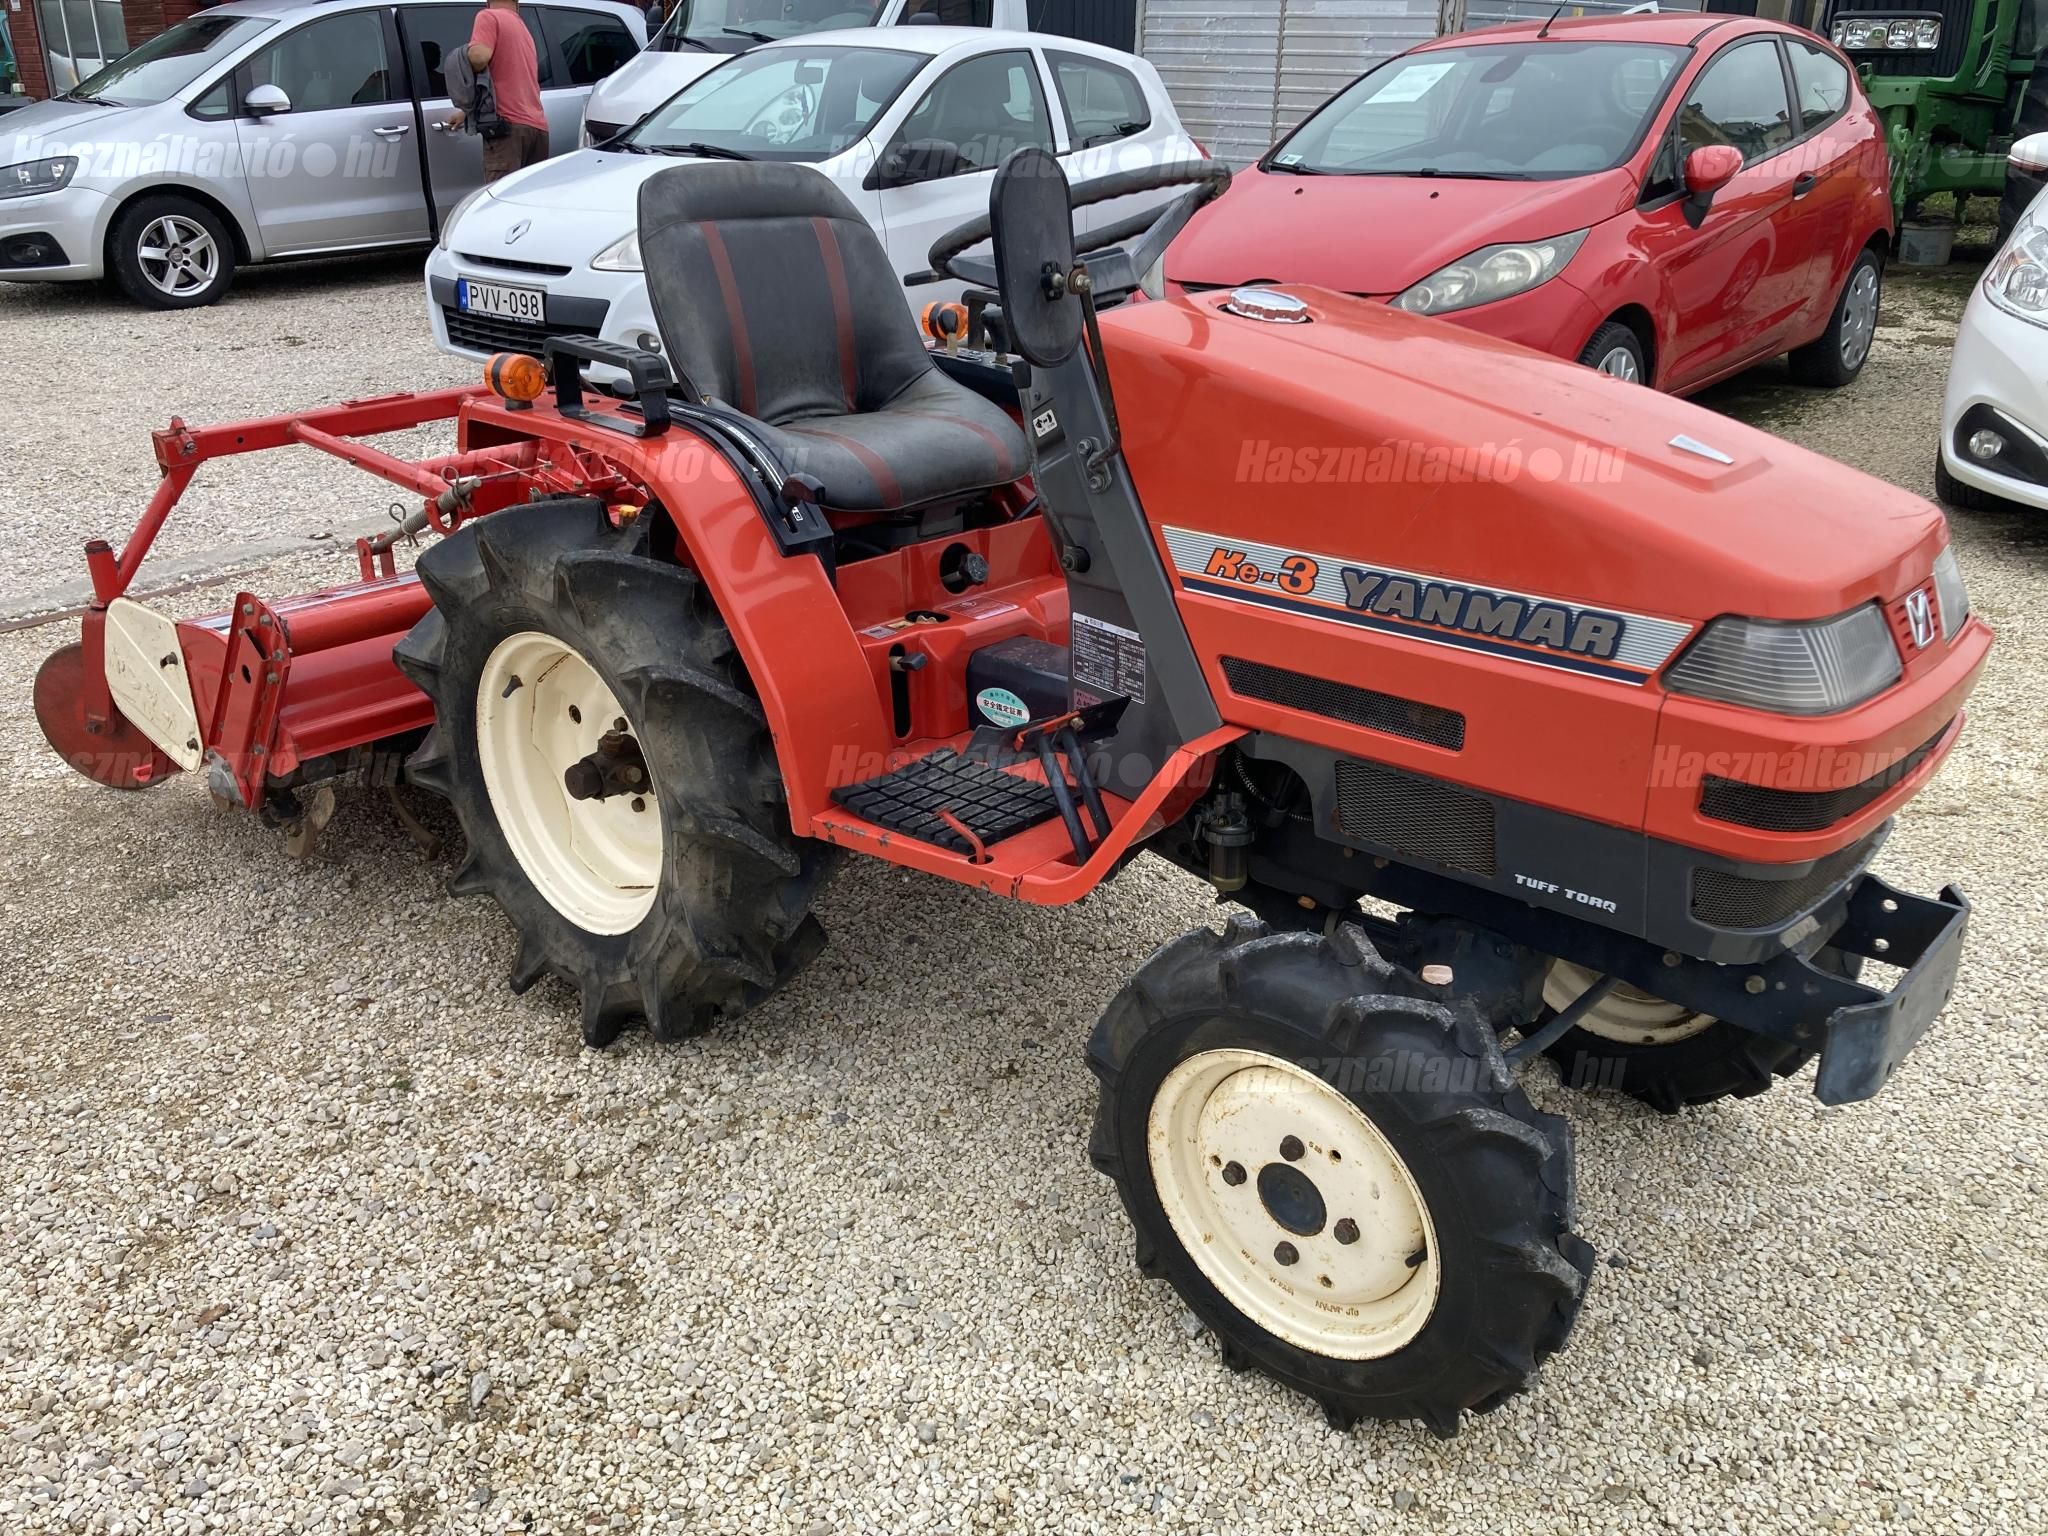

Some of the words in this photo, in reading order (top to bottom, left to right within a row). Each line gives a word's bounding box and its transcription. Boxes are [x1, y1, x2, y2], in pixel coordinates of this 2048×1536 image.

[469, 285, 540, 318] PVV-098
[1203, 547, 1320, 596] Ke-3
[1341, 567, 1626, 661] YANMAR
[1514, 873, 1560, 894] TUFF
[1564, 888, 1617, 914] TORQ
